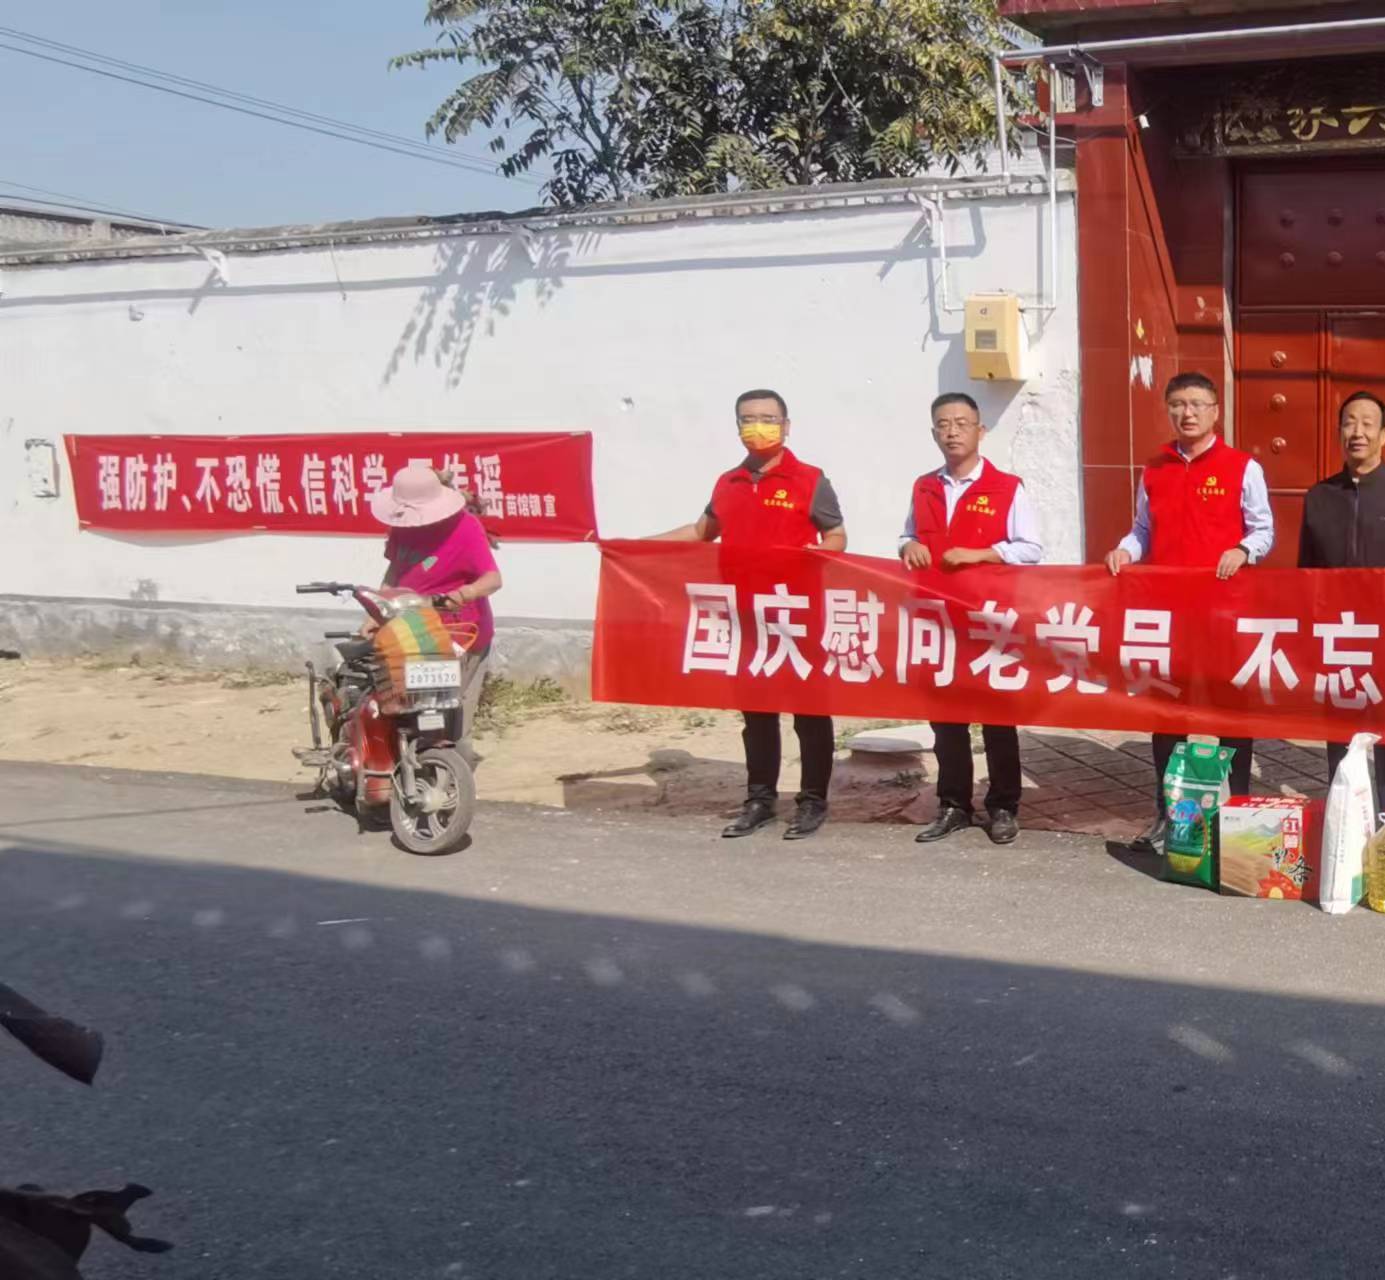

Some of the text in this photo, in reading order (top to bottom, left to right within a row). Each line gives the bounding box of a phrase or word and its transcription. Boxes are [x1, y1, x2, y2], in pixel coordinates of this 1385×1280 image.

[98, 453, 504, 519] 强防护、不恐慌、信科学传谣
[681, 582, 1181, 698] 国庆慰问老党员
